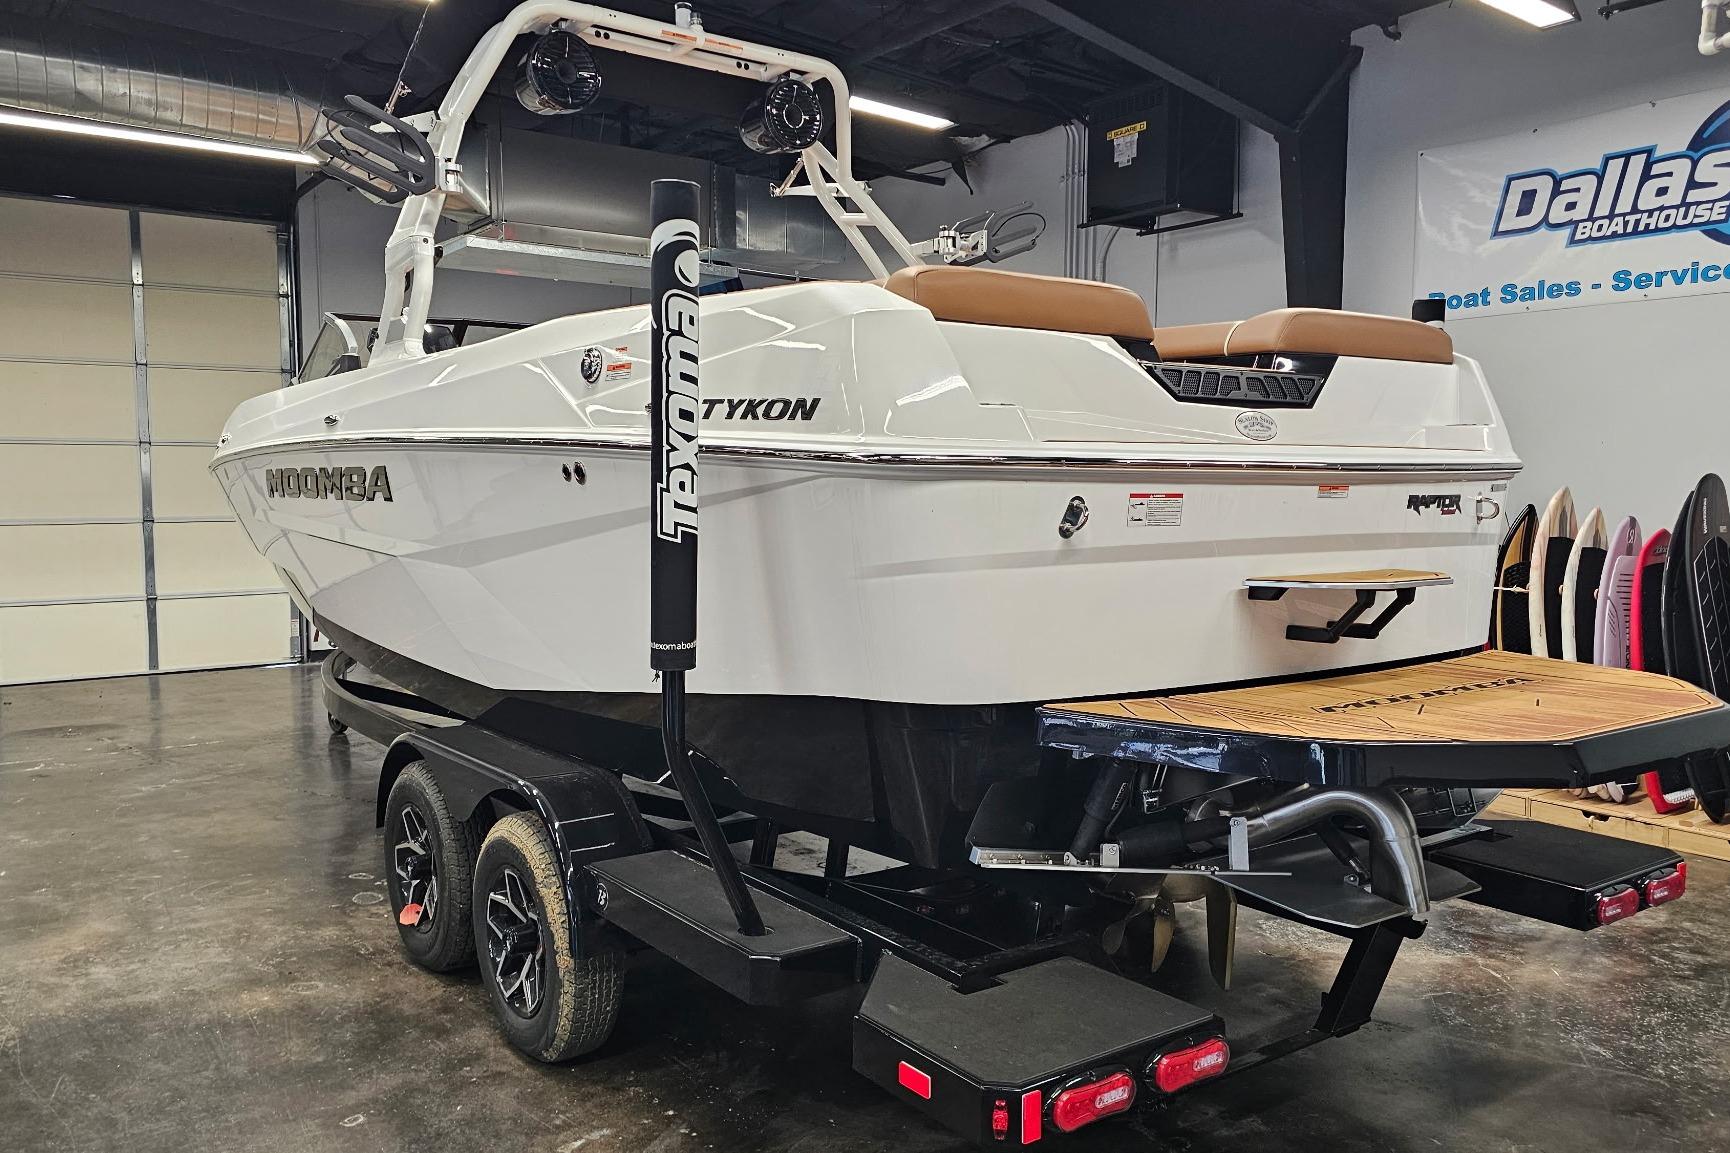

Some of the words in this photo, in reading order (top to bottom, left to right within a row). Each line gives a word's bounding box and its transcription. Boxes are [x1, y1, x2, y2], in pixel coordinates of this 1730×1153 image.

[1493, 149, 1730, 236] Dallas
[1573, 200, 1730, 242] BOATHOUSE
[1499, 280, 1582, 304] Sales
[660, 292, 699, 540] Texoma
[701, 397, 822, 421] TYKON
[265, 464, 394, 503] MOOMBA
[1406, 494, 1462, 516] RAPTOR
